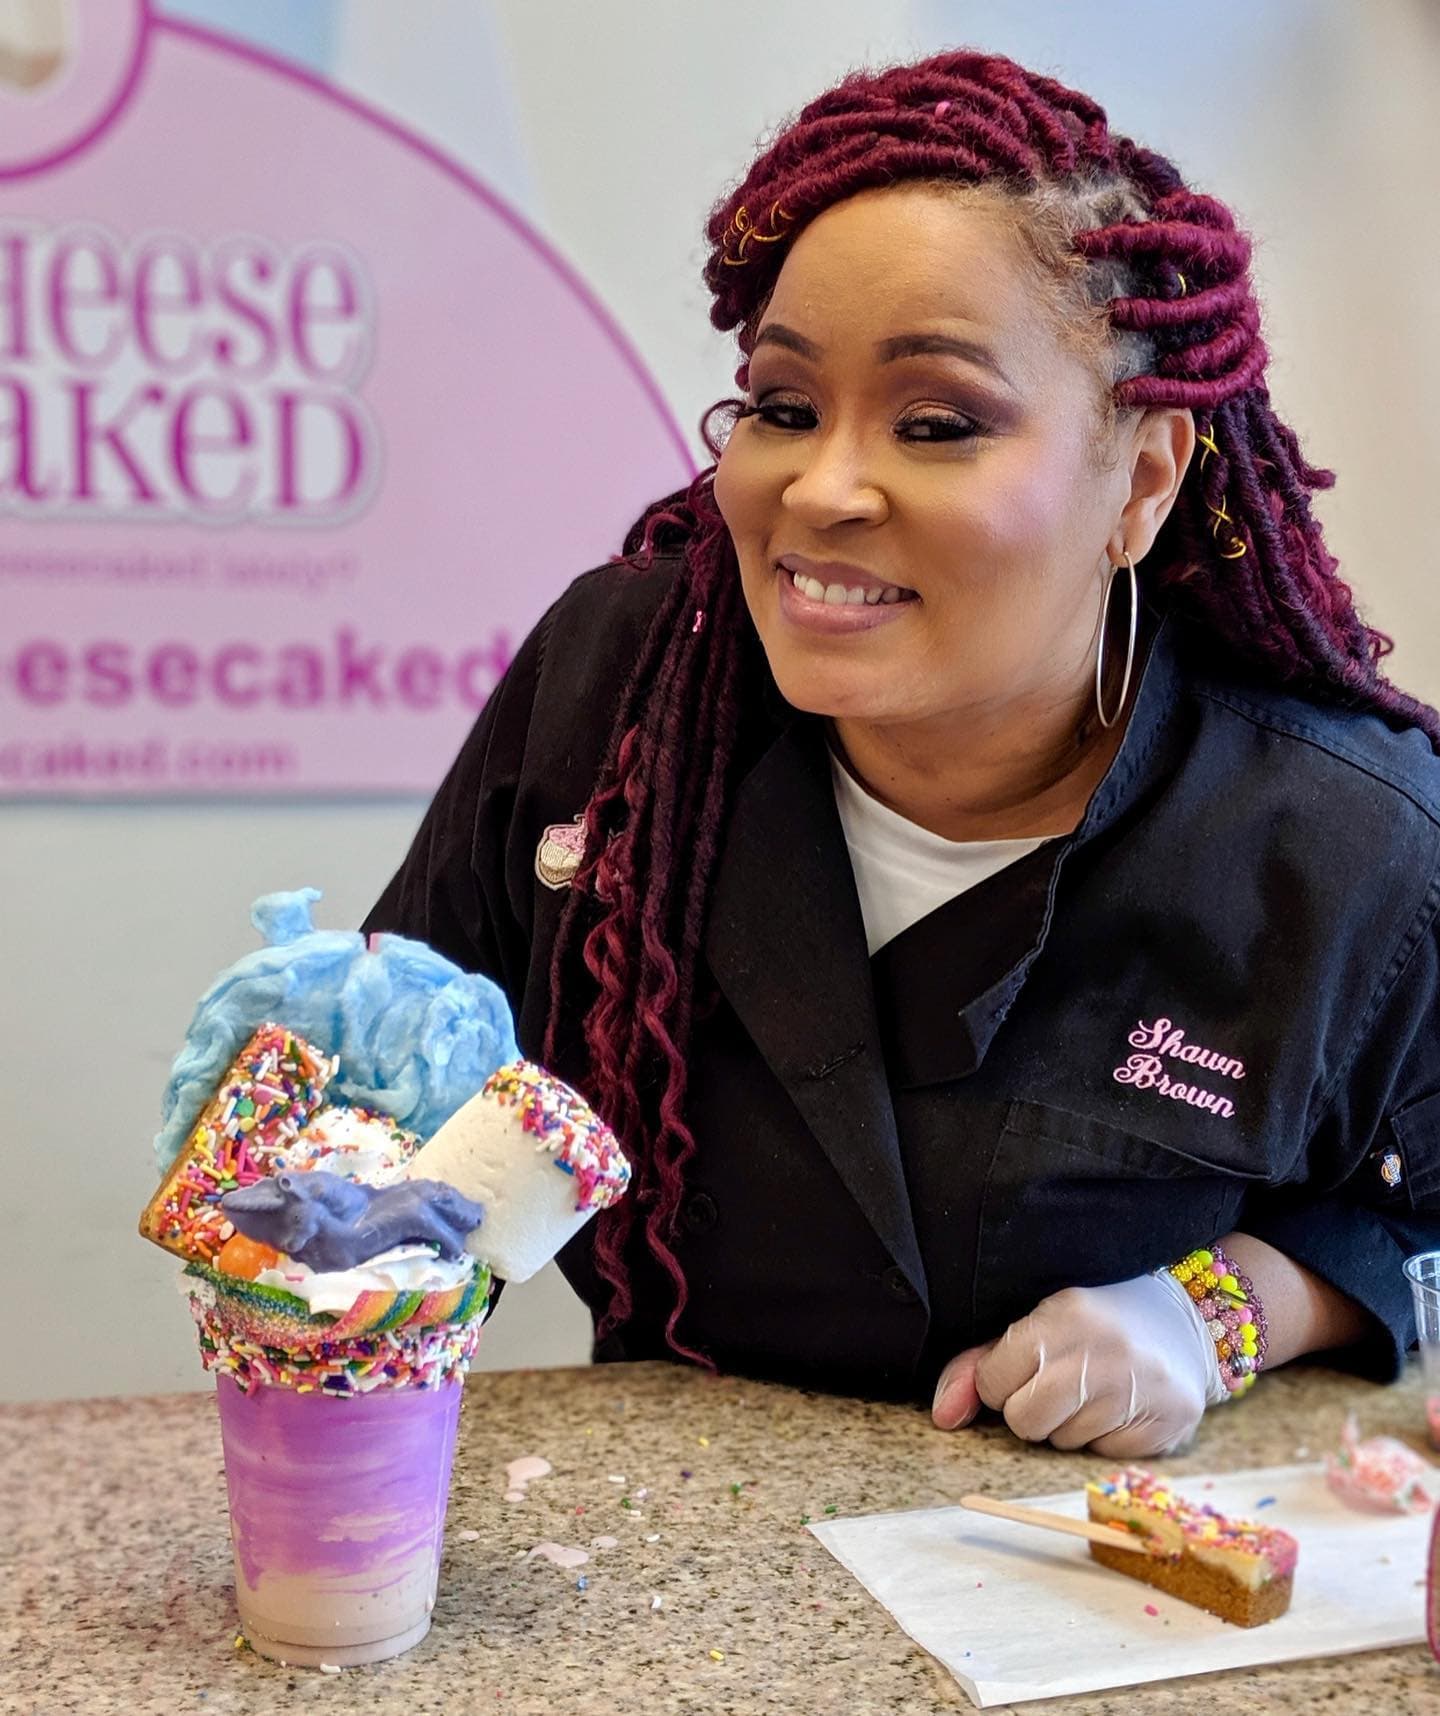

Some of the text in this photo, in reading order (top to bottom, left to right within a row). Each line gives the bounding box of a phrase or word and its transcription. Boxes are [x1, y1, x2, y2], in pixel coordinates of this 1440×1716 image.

[0, 624, 513, 710] esecaked
[1128, 1018, 1246, 1079] Shawn
[1113, 1053, 1235, 1119] Brown
